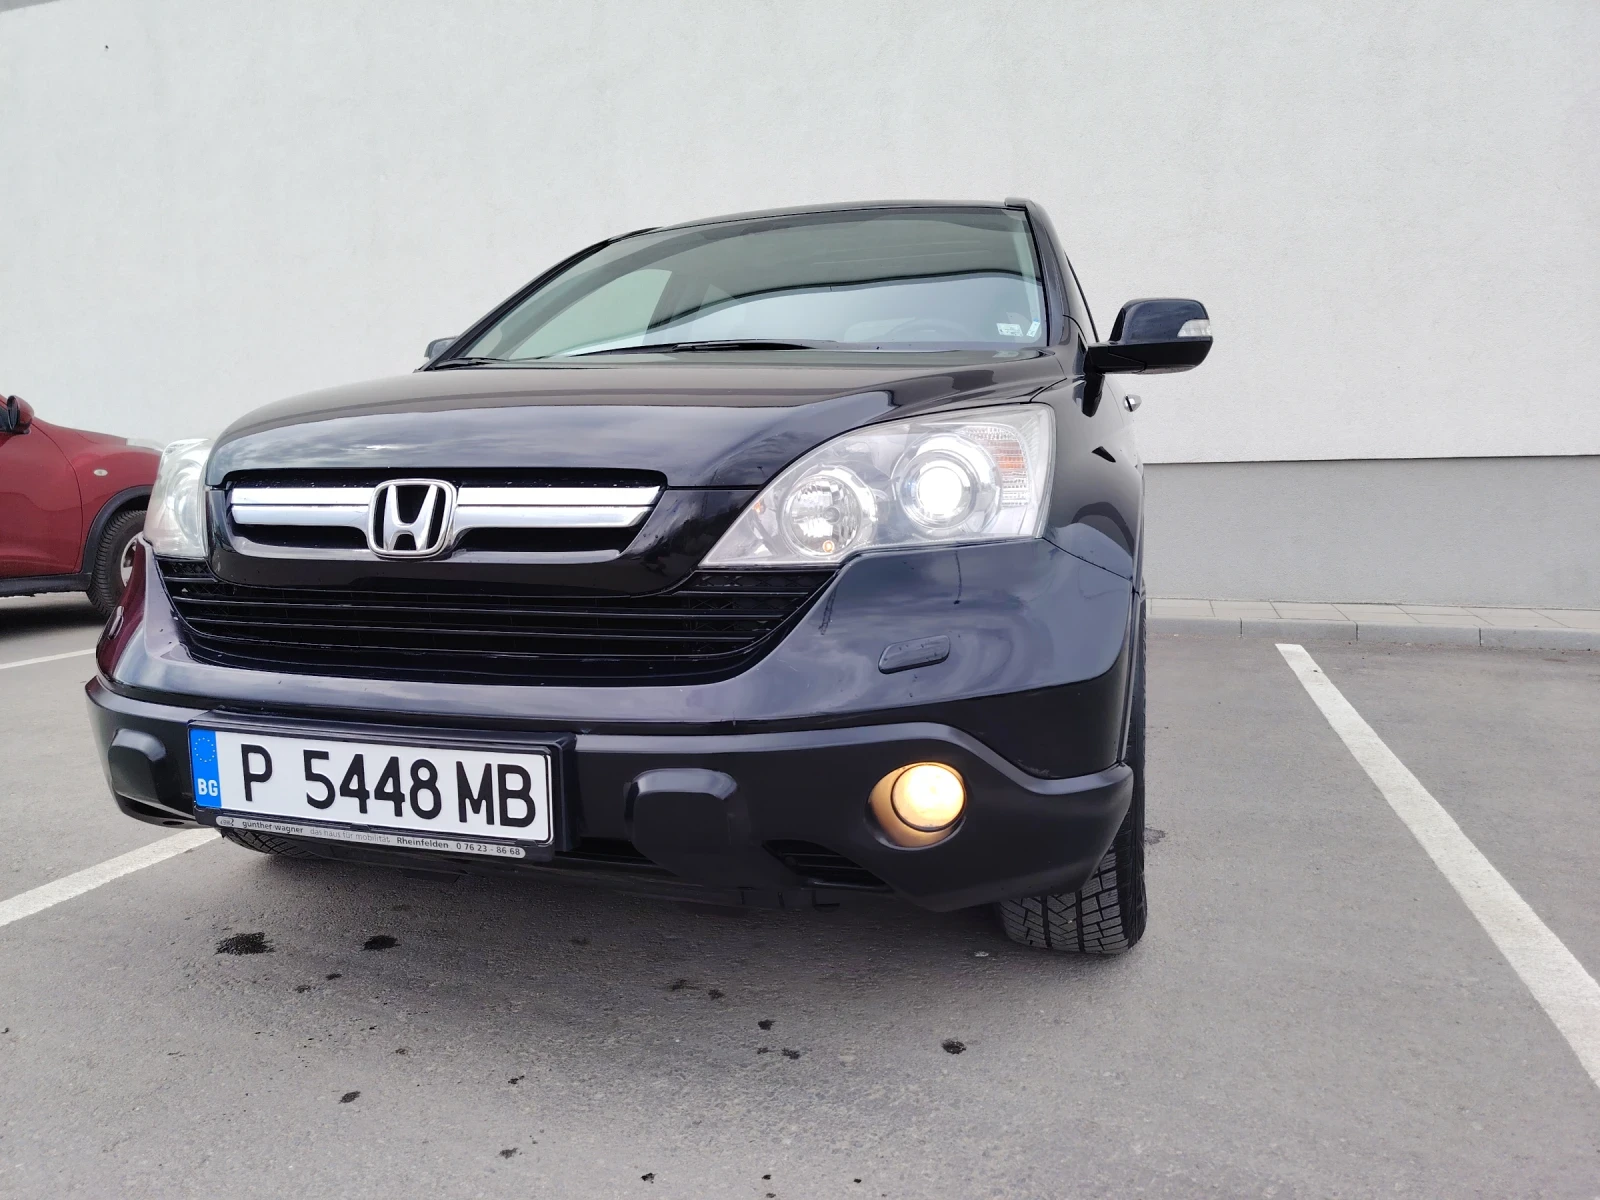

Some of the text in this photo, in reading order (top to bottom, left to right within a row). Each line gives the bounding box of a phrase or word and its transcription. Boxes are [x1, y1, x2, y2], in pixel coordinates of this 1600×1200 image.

[197, 778, 218, 796] BG
[241, 744, 536, 827] P 5448 MB
[274, 824, 304, 834] wagner
[310, 827, 322, 836] das
[323, 829, 341, 838] haus
[396, 837, 449, 848] Rheinfelden
